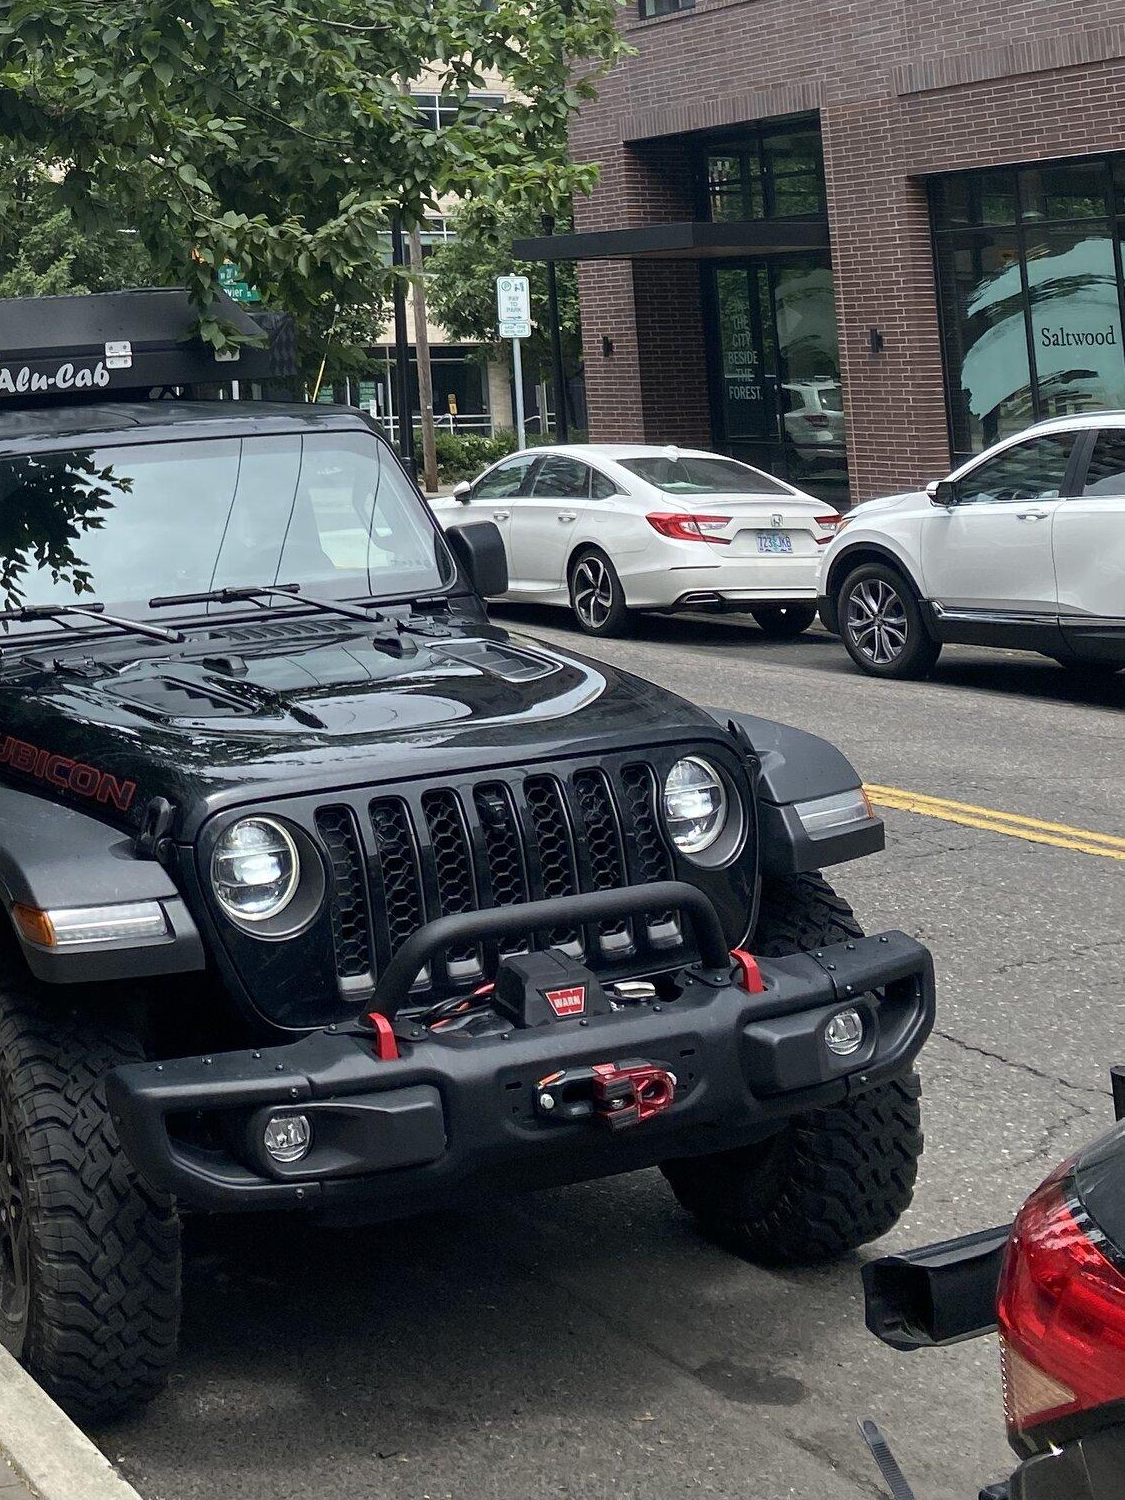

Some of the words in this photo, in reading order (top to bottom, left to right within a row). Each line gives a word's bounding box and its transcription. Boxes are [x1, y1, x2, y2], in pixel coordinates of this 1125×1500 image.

[732, 332, 751, 347] CITY
[1041, 325, 1117, 347] Saltwood
[729, 351, 759, 365] BESIDE
[735, 368, 754, 382] THE
[729, 386, 764, 400] FOREST.
[758, 536, 773, 548] 723
[553, 995, 581, 1008] WARN
